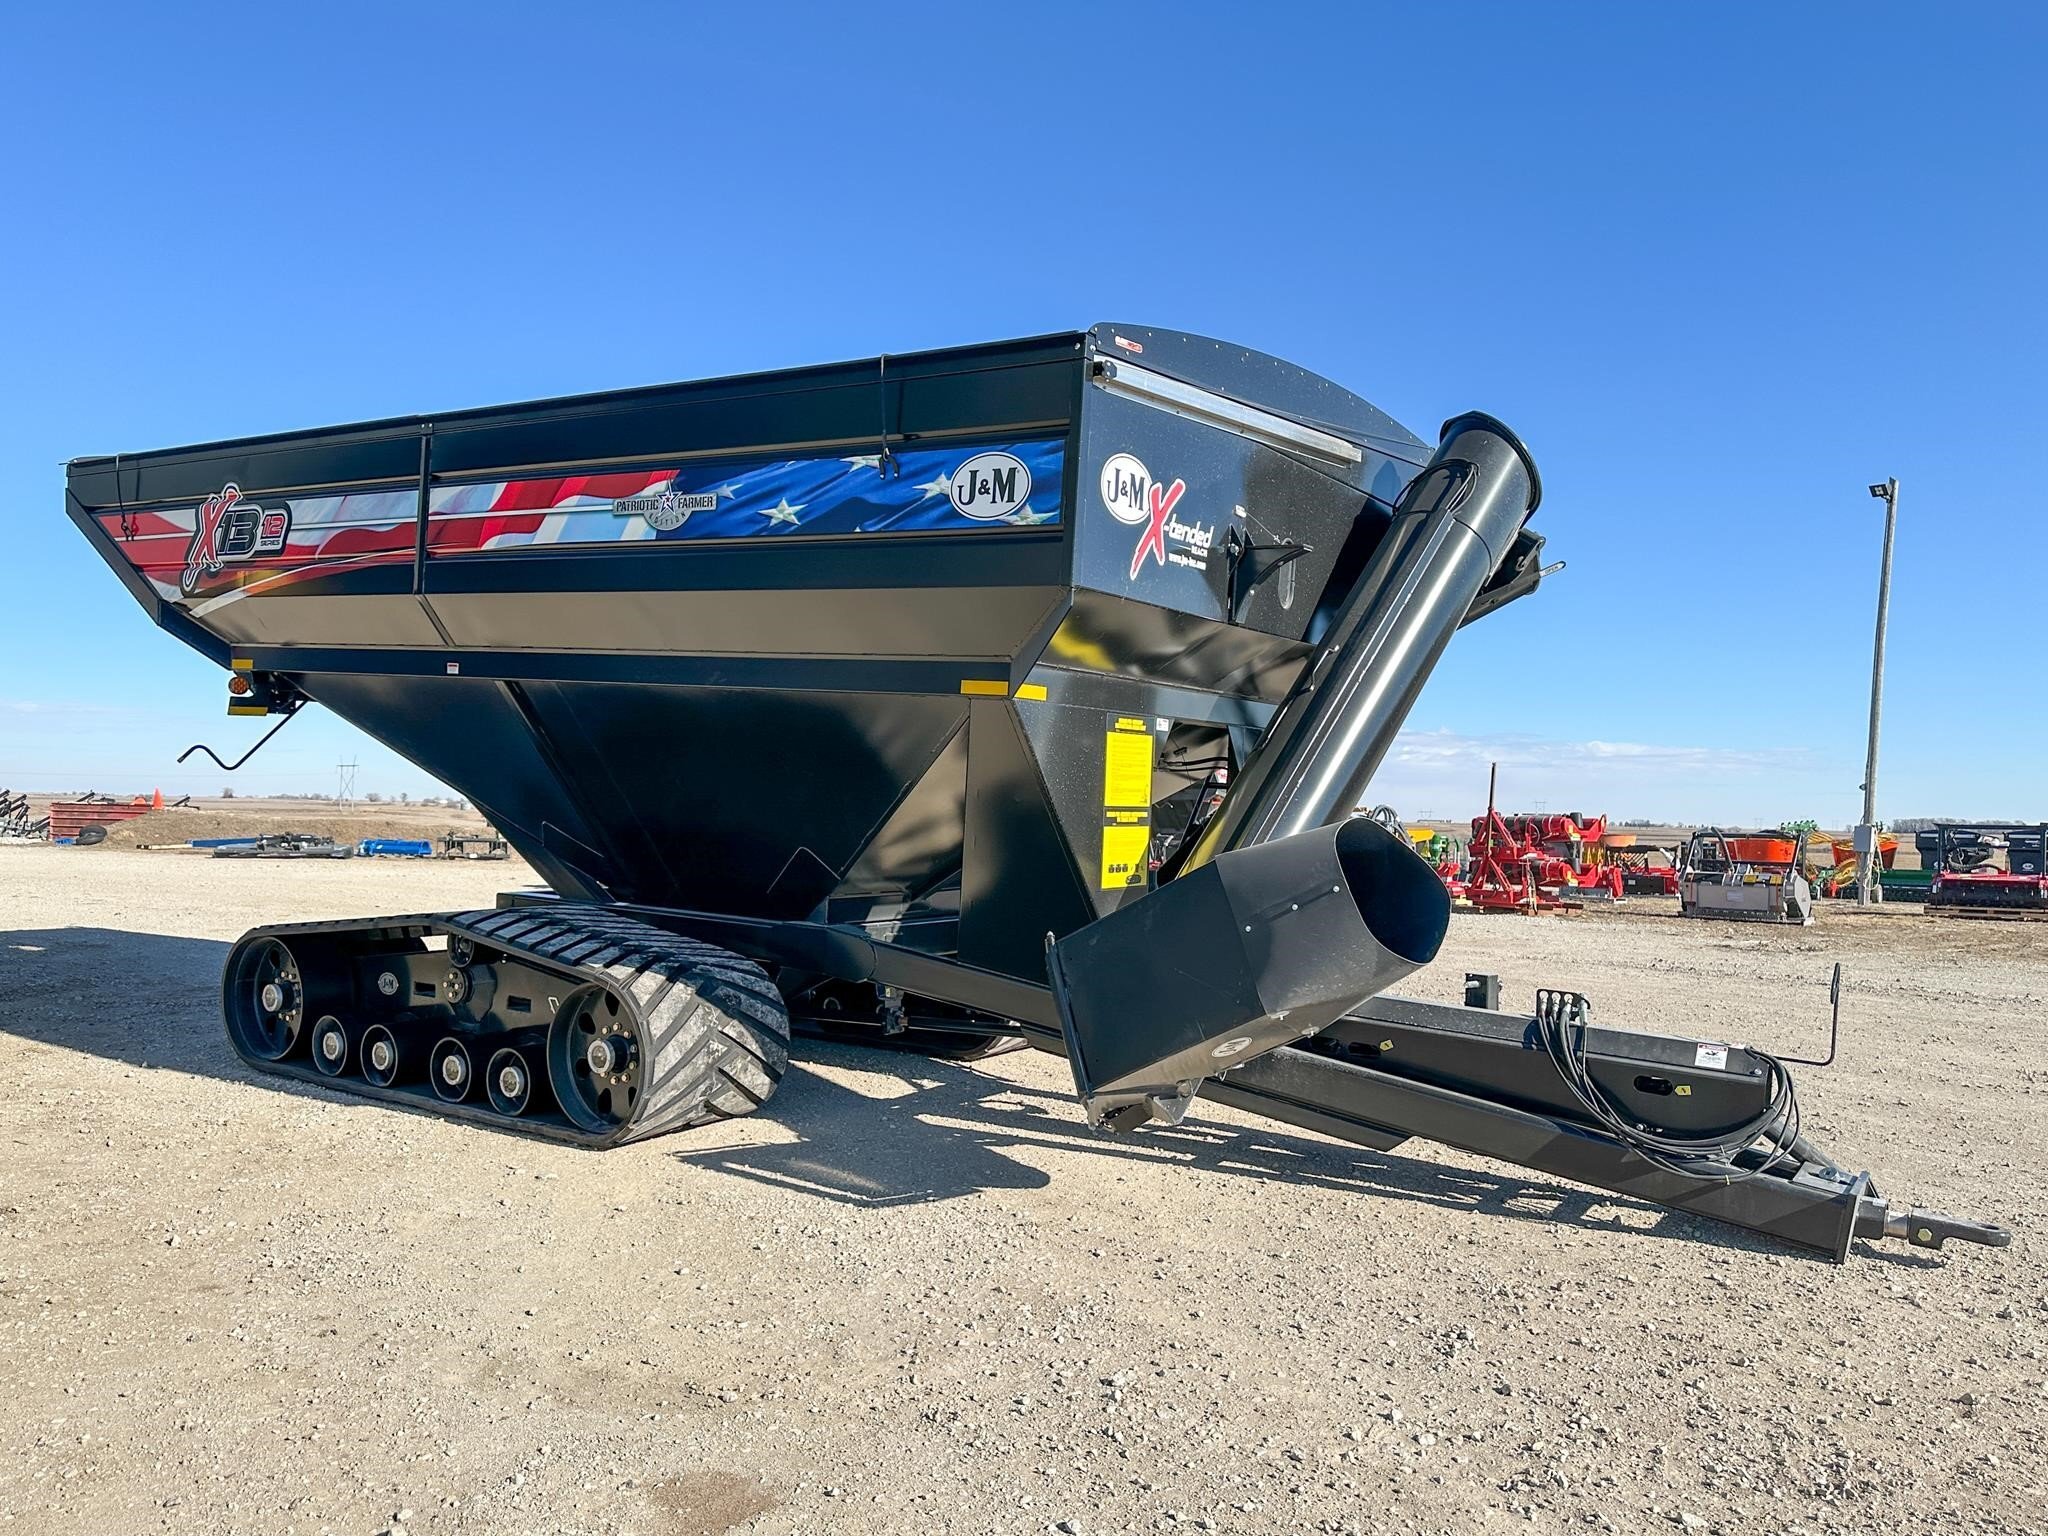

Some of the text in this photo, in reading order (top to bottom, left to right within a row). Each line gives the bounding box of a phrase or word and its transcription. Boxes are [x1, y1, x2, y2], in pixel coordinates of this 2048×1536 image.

[957, 467, 1018, 506] J&M
[1106, 467, 1146, 512] J&M
[616, 495, 713, 512] PATRIOTIC FARMER
[262, 515, 284, 537] 12
[648, 511, 687, 526] EDITION
